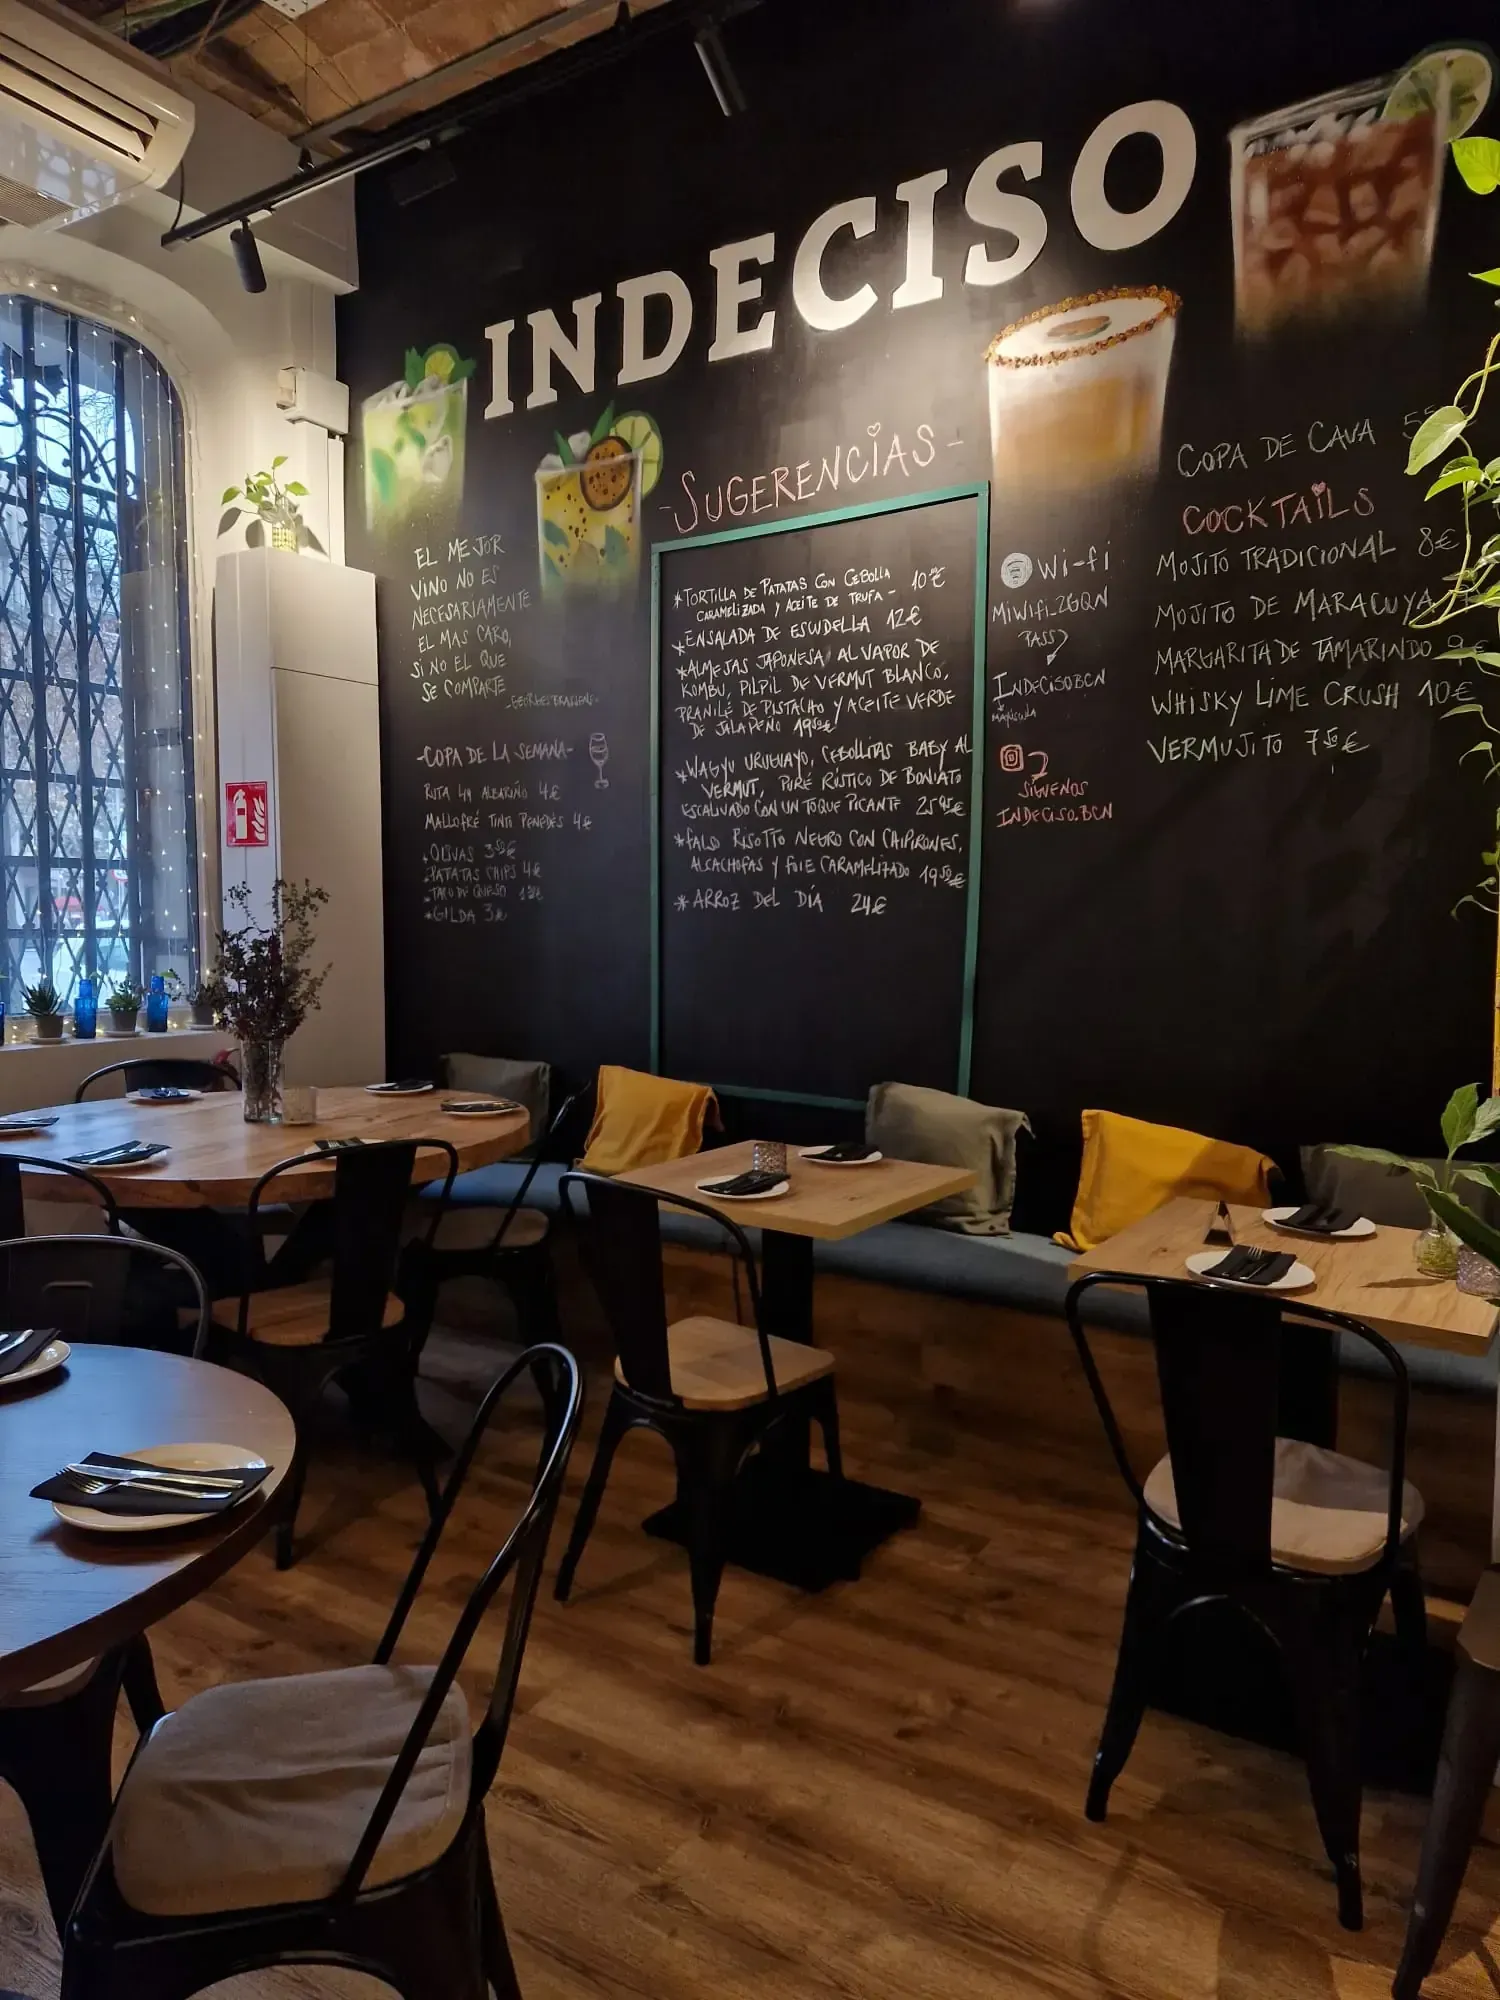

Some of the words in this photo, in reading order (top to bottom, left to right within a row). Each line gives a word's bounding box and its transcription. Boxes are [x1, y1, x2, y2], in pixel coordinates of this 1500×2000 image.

[484, 100, 1197, 420] INDECISO
[1177, 442, 1248, 477] COPA
[1260, 434, 1297, 462] DE
[1307, 418, 1376, 453] CAVA
[1182, 481, 1374, 535] COCKTAILS
[413, 548, 437, 570] EL
[447, 534, 506, 564] MEJOR
[1156, 549, 1229, 581] MOJITO
[1241, 530, 1396, 574] TRADICIONAL
[1417, 527, 1460, 557] 8€
[410, 576, 448, 601] VINO
[456, 567, 474, 591] NO
[481, 565, 499, 586] ES
[683, 586, 737, 607] TORTILLA
[744, 586, 757, 600] DE
[759, 577, 807, 596] PATATAS
[815, 573, 836, 589] CON
[844, 566, 891, 587] CEBOLLA
[411, 588, 532, 631] NECESARIAMENTE
[696, 602, 766, 622] CARAMELIZADA
[785, 595, 818, 613] ACEITE
[824, 595, 839, 608] DE
[848, 589, 884, 605] TRUFA
[1154, 600, 1236, 632] MOJITO
[1250, 595, 1280, 621] DE
[418, 636, 435, 653] EL
[439, 629, 469, 649] MAS
[684, 628, 755, 651] ENSALADA
[761, 626, 782, 643] DE
[886, 605, 922, 630] 12€
[1017, 629, 1056, 648] PASS
[410, 658, 425, 679] SI
[429, 657, 447, 676] NO
[454, 653, 472, 673] EL
[479, 649, 508, 669] QUE
[687, 658, 749, 684] ALMEJAS
[837, 643, 859, 663] AL
[861, 642, 910, 662] VAPOR
[915, 638, 940, 658] DE
[1154, 642, 1272, 676] MARGARITA
[1273, 638, 1300, 665] DE
[1312, 636, 1432, 669] TAMARINDO
[421, 682, 438, 703] SE
[444, 675, 507, 700] COMPARTE
[739, 675, 782, 697] PILPIL
[790, 674, 810, 692] DE
[814, 668, 876, 690] VERMUT
[740, 700, 757, 717] DE
[760, 697, 825, 716] PISTACHO
[847, 691, 900, 714] ACEITE
[906, 689, 956, 711] VERDE
[1151, 688, 1243, 727] WHISKY
[1256, 677, 1309, 712] LIME
[1323, 680, 1400, 709] CRUSH
[1417, 680, 1477, 707] 10€
[688, 722, 705, 740] DE
[1147, 731, 1283, 763] VERMUJITO
[466, 746, 488, 765] DE
[492, 740, 510, 763] LA
[685, 755, 735, 784] WAGYU
[905, 739, 949, 771] BABY
[954, 733, 973, 753] AL
[778, 772, 813, 791] PURÉ
[879, 769, 899, 787] DE
[902, 766, 962, 787] BONIATO
[754, 798, 778, 817] CON
[781, 800, 799, 815] UN
[801, 797, 841, 815] TOQUE
[845, 793, 901, 813] PICANTE
[732, 827, 786, 850] RISOTTO
[795, 825, 842, 848] NEGRO
[849, 829, 875, 848] CON
[693, 888, 741, 911] ARROZ
[752, 887, 781, 909] DEL
[794, 884, 824, 913] DÍA
[851, 892, 887, 916] 24€
